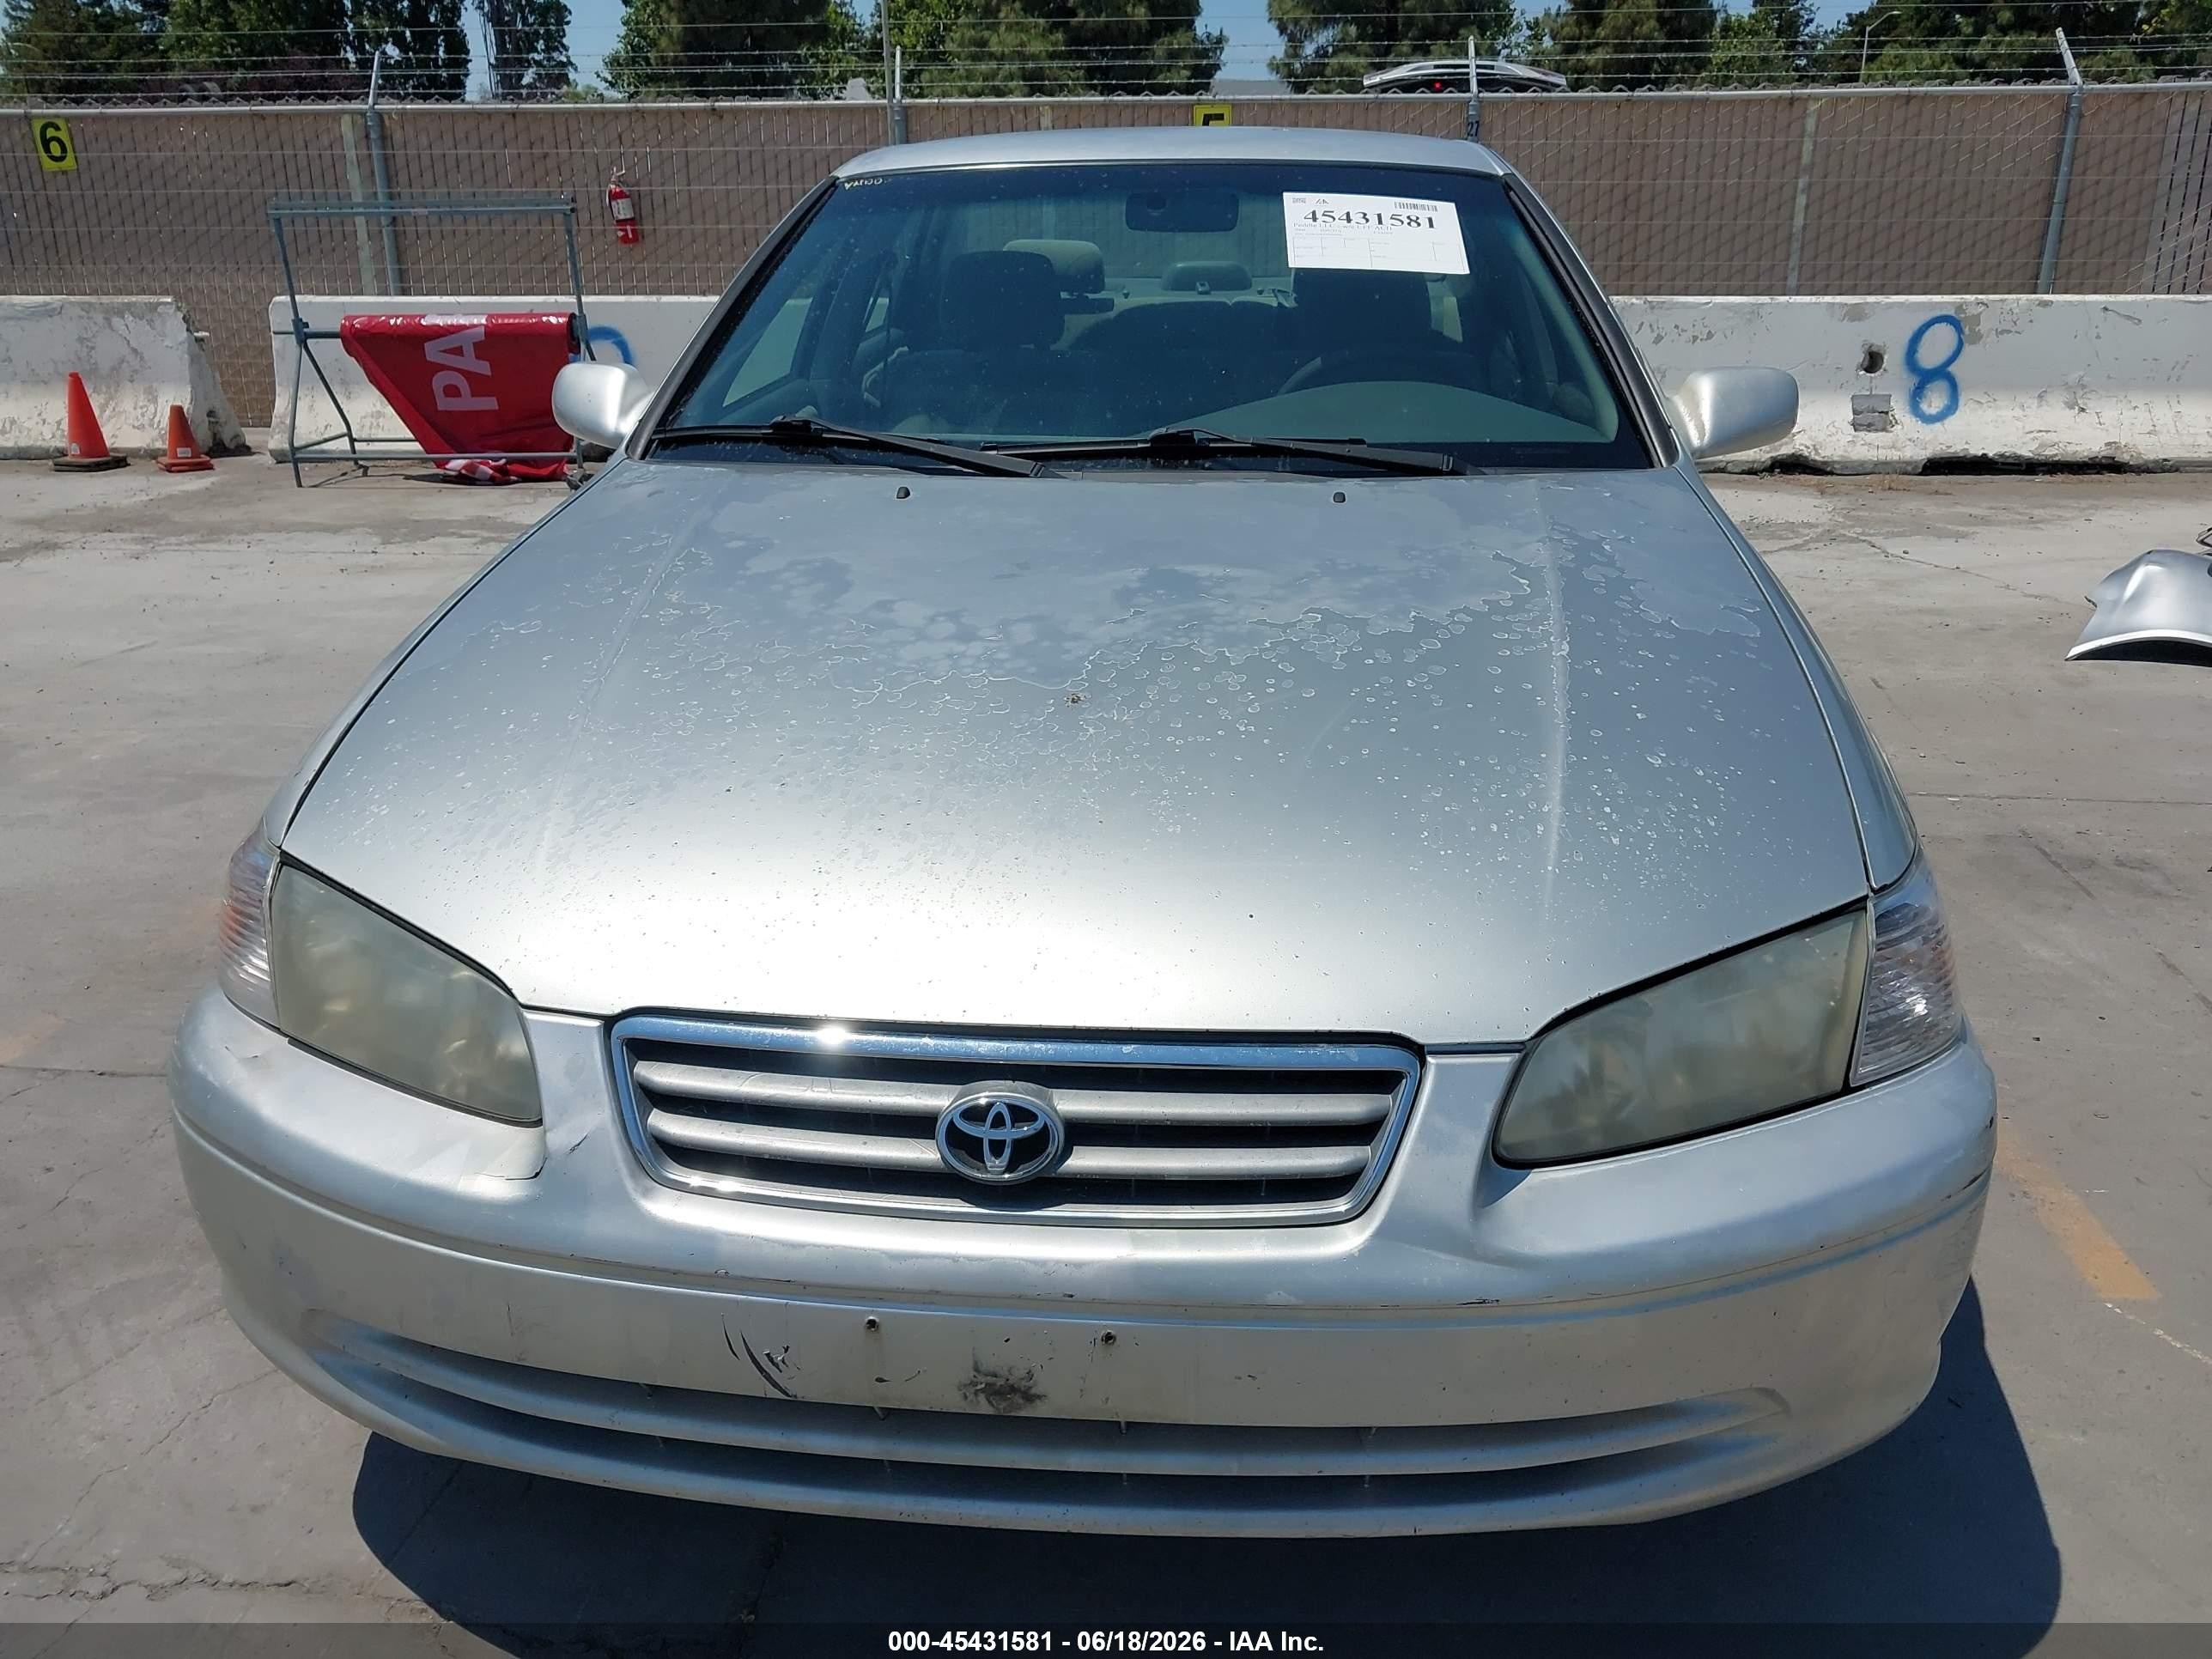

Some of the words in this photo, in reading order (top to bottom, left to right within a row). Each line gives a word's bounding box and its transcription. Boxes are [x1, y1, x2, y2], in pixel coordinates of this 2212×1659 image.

[40, 121, 68, 162] 6
[1303, 209, 1436, 228] 45431581
[424, 325, 500, 411] PA
[1903, 313, 1966, 426] 8
